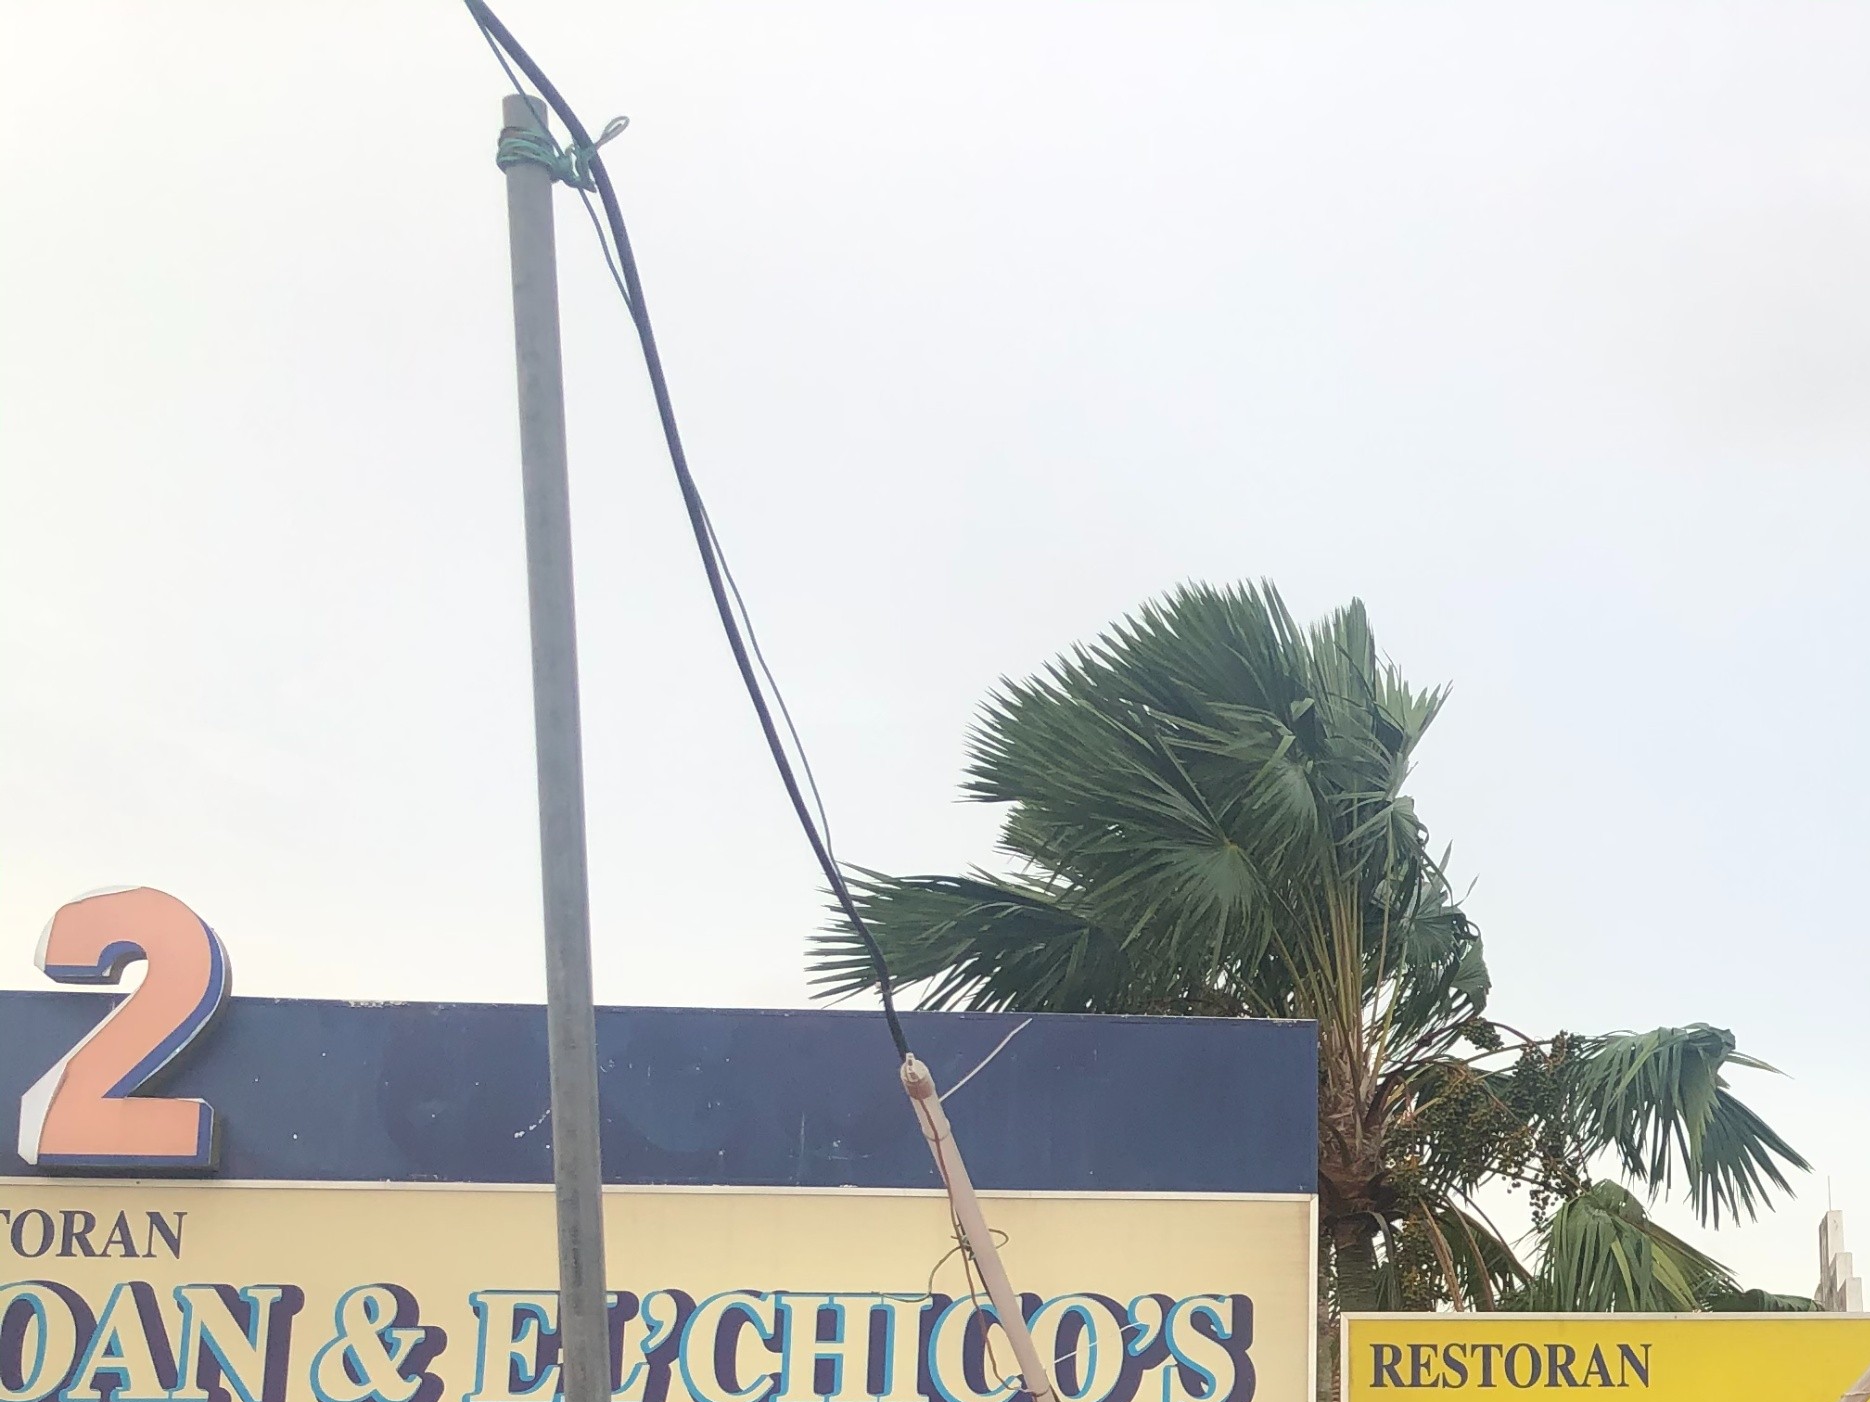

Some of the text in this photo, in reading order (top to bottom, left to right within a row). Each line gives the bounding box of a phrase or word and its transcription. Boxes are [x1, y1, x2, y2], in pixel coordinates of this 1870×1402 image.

[18, 885, 232, 1169] 2
[0, 1209, 188, 1260] ORAN
[1368, 1342, 1653, 1390] RESTORAN
